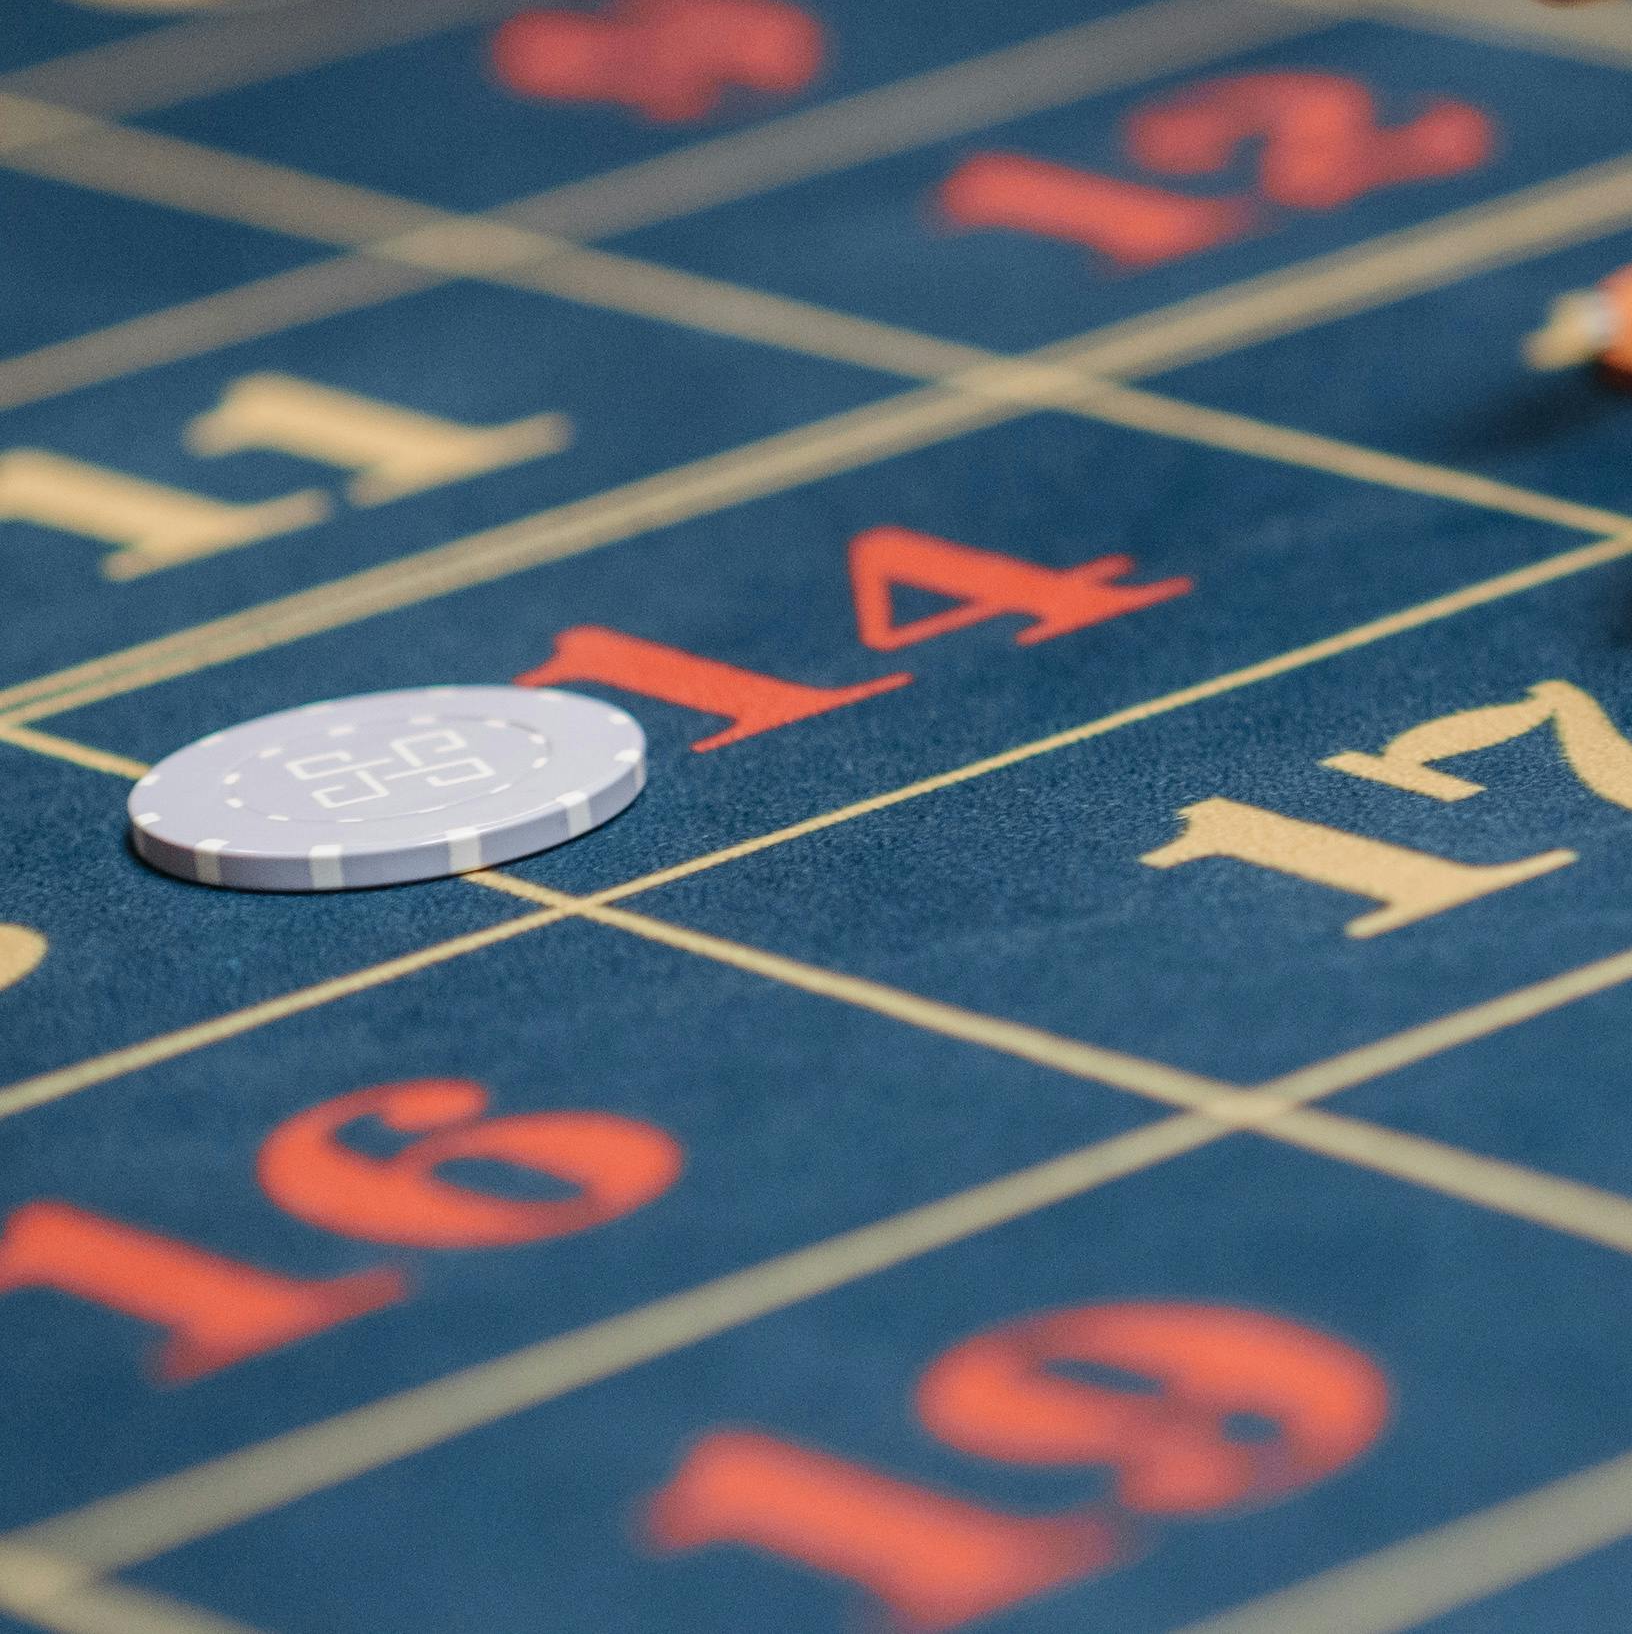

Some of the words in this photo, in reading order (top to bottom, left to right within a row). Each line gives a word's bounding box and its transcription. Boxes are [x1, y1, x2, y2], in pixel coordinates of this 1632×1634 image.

[928, 70, 1492, 274] 12
[0, 373, 572, 580] 11
[512, 526, 1193, 753] 14
[0, 1077, 684, 1386] 16
[634, 1298, 1391, 1630] 19
